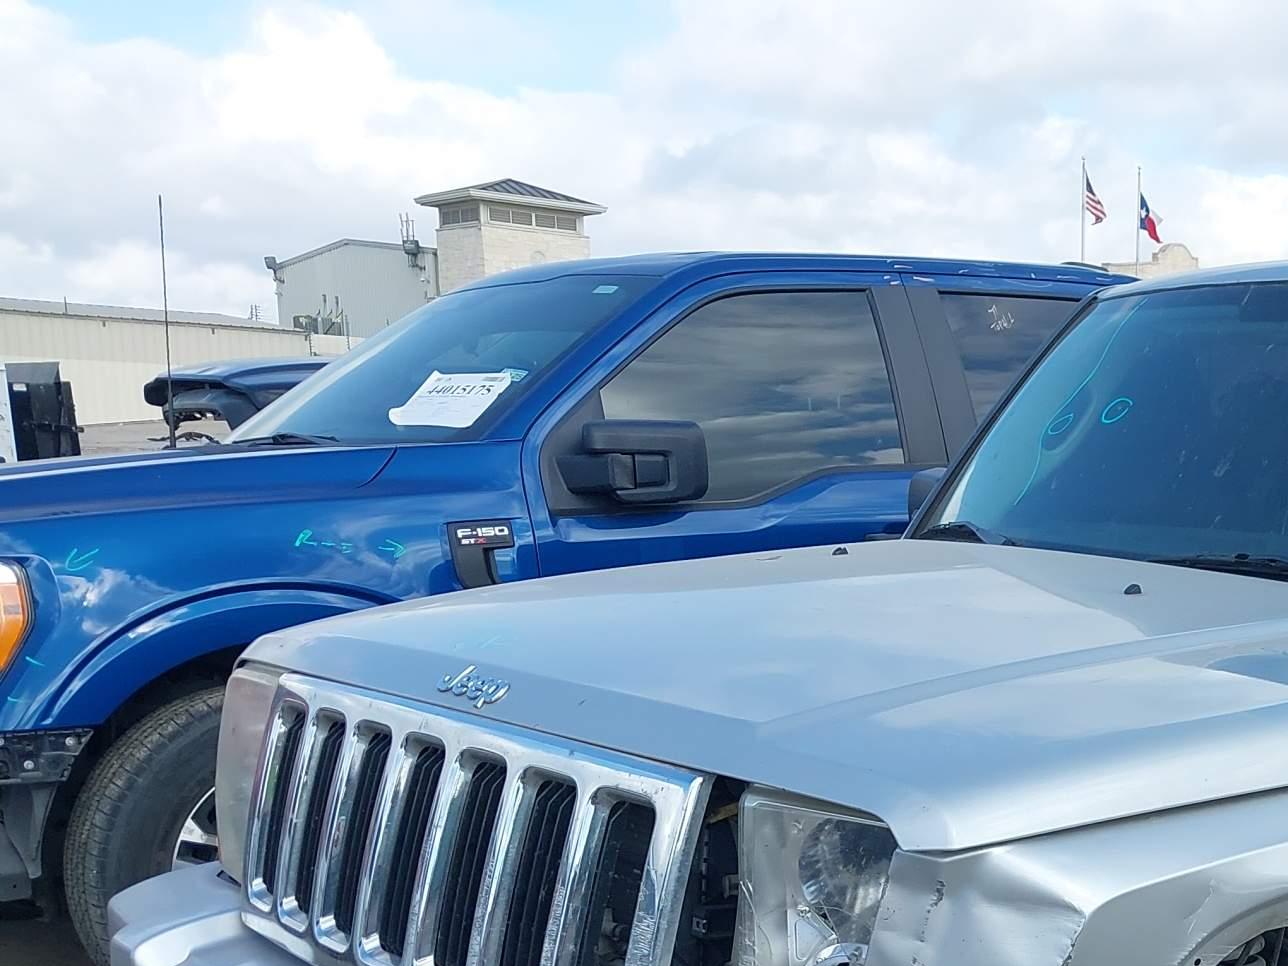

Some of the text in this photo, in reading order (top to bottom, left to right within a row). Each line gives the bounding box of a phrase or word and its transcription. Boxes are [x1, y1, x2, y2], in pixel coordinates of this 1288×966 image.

[427, 384, 495, 396] 44015175
[456, 526, 509, 538] F-150
[436, 663, 511, 709] Jeep
